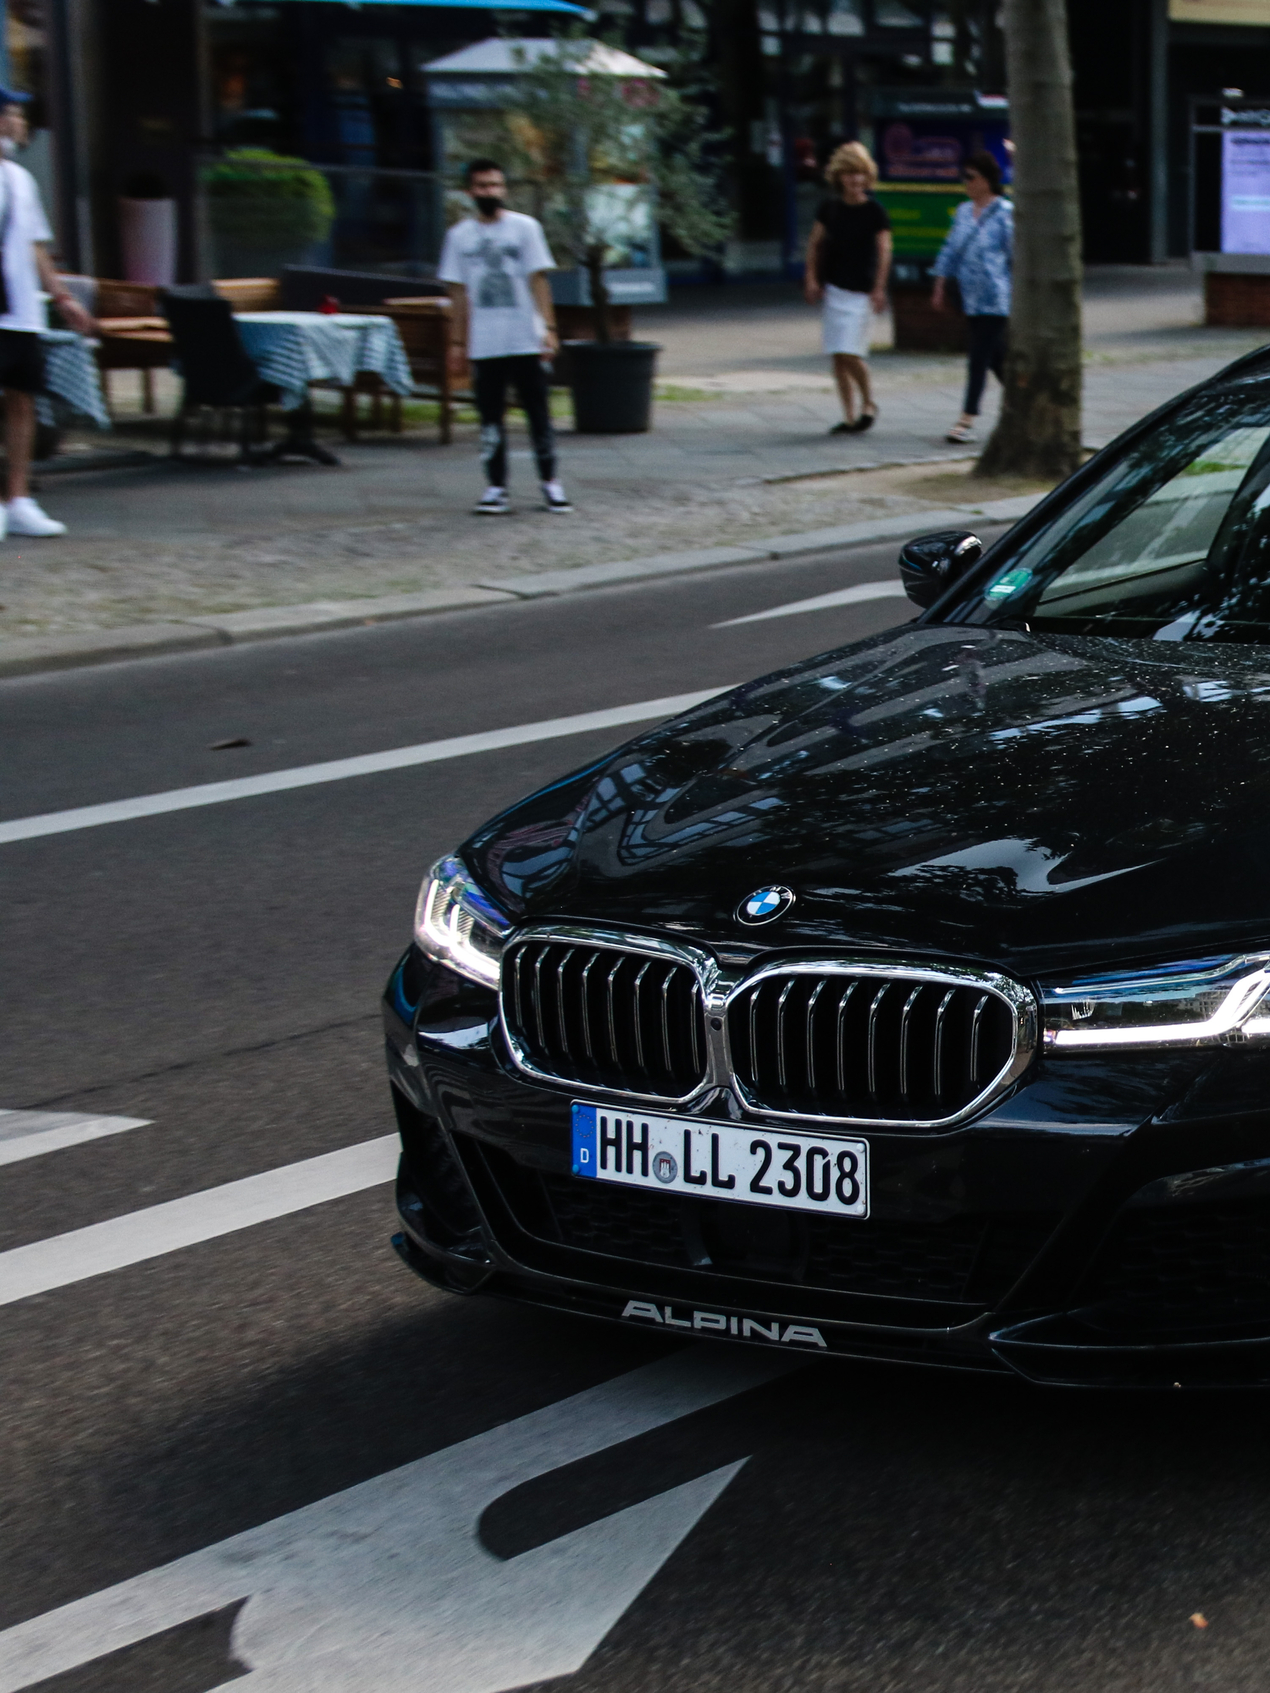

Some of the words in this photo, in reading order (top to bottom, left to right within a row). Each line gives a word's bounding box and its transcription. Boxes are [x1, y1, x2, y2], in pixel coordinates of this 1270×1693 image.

[580, 1148, 589, 1163] D
[600, 1116, 649, 1177] HH
[683, 1129, 736, 1190] LL
[750, 1139, 860, 1205] 2308
[621, 1300, 828, 1347] ALPINA
